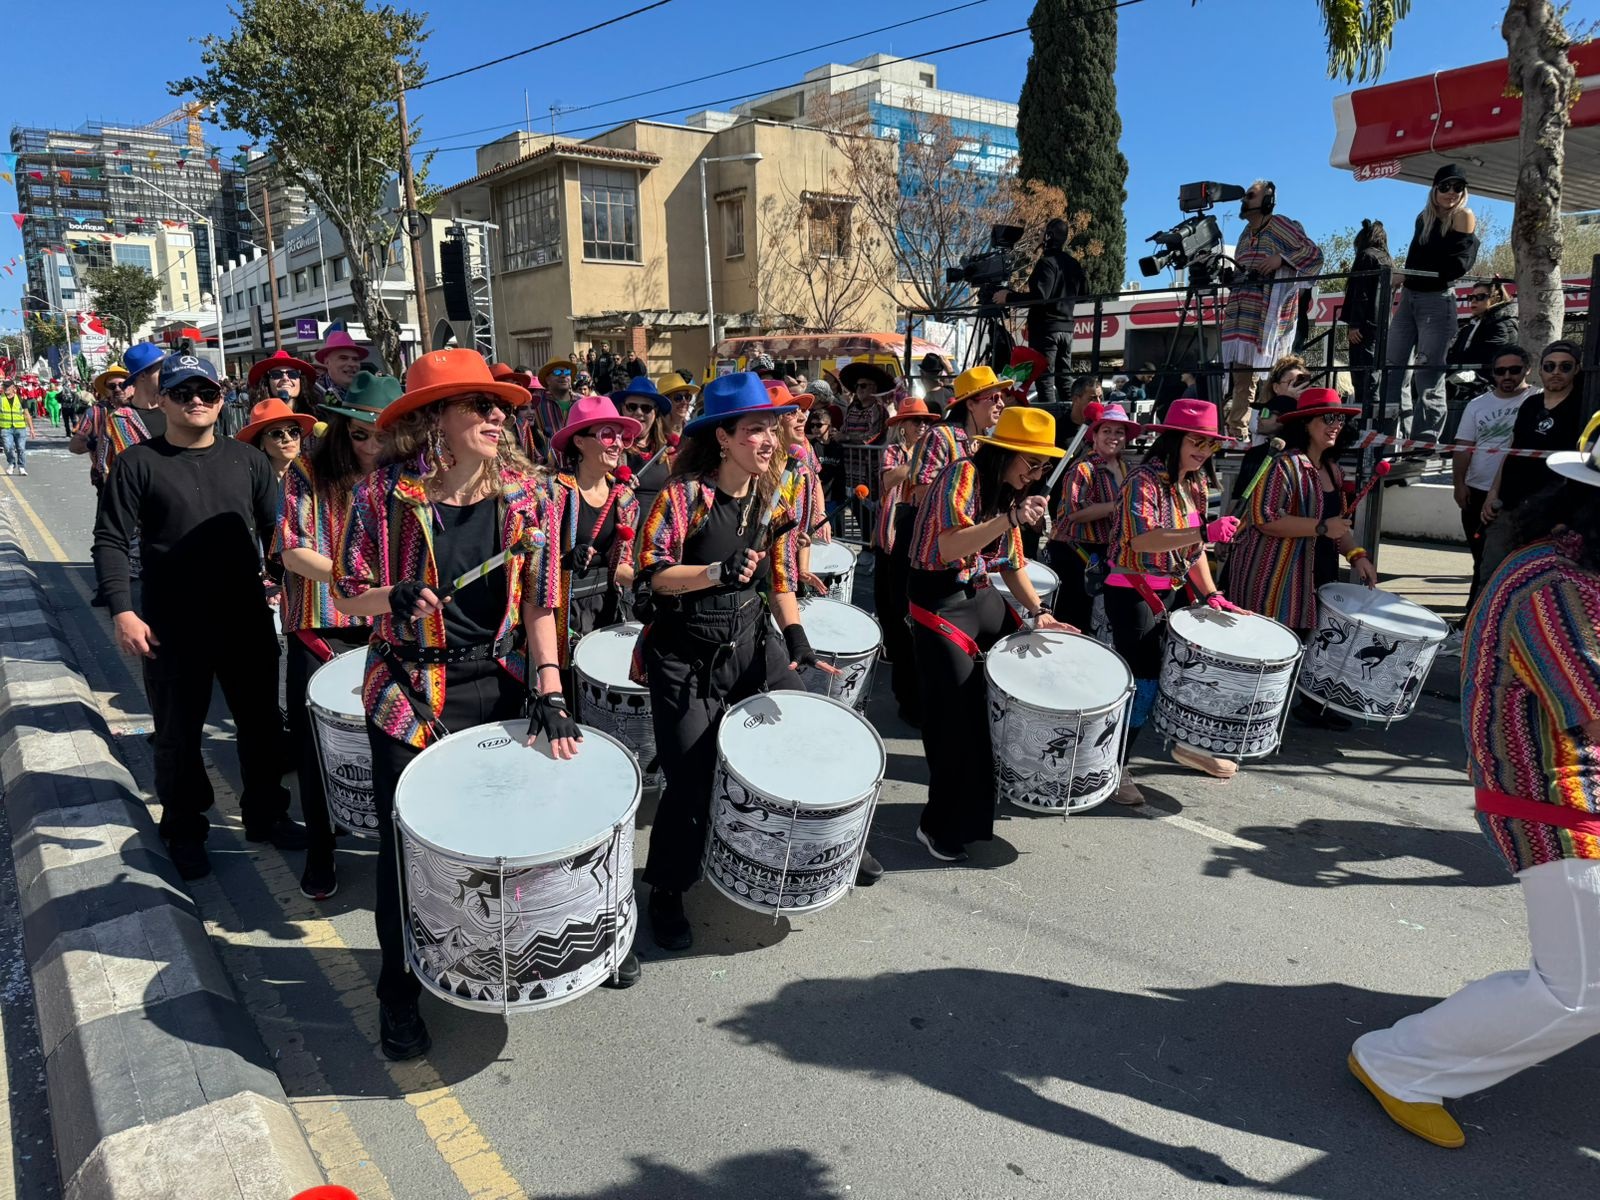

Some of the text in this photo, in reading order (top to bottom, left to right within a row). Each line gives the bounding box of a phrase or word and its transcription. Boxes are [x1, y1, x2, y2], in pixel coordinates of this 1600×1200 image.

[1361, 164, 1393, 177] 4.2m
[68, 222, 105, 231] boutique
[481, 738, 509, 749] IZZO
